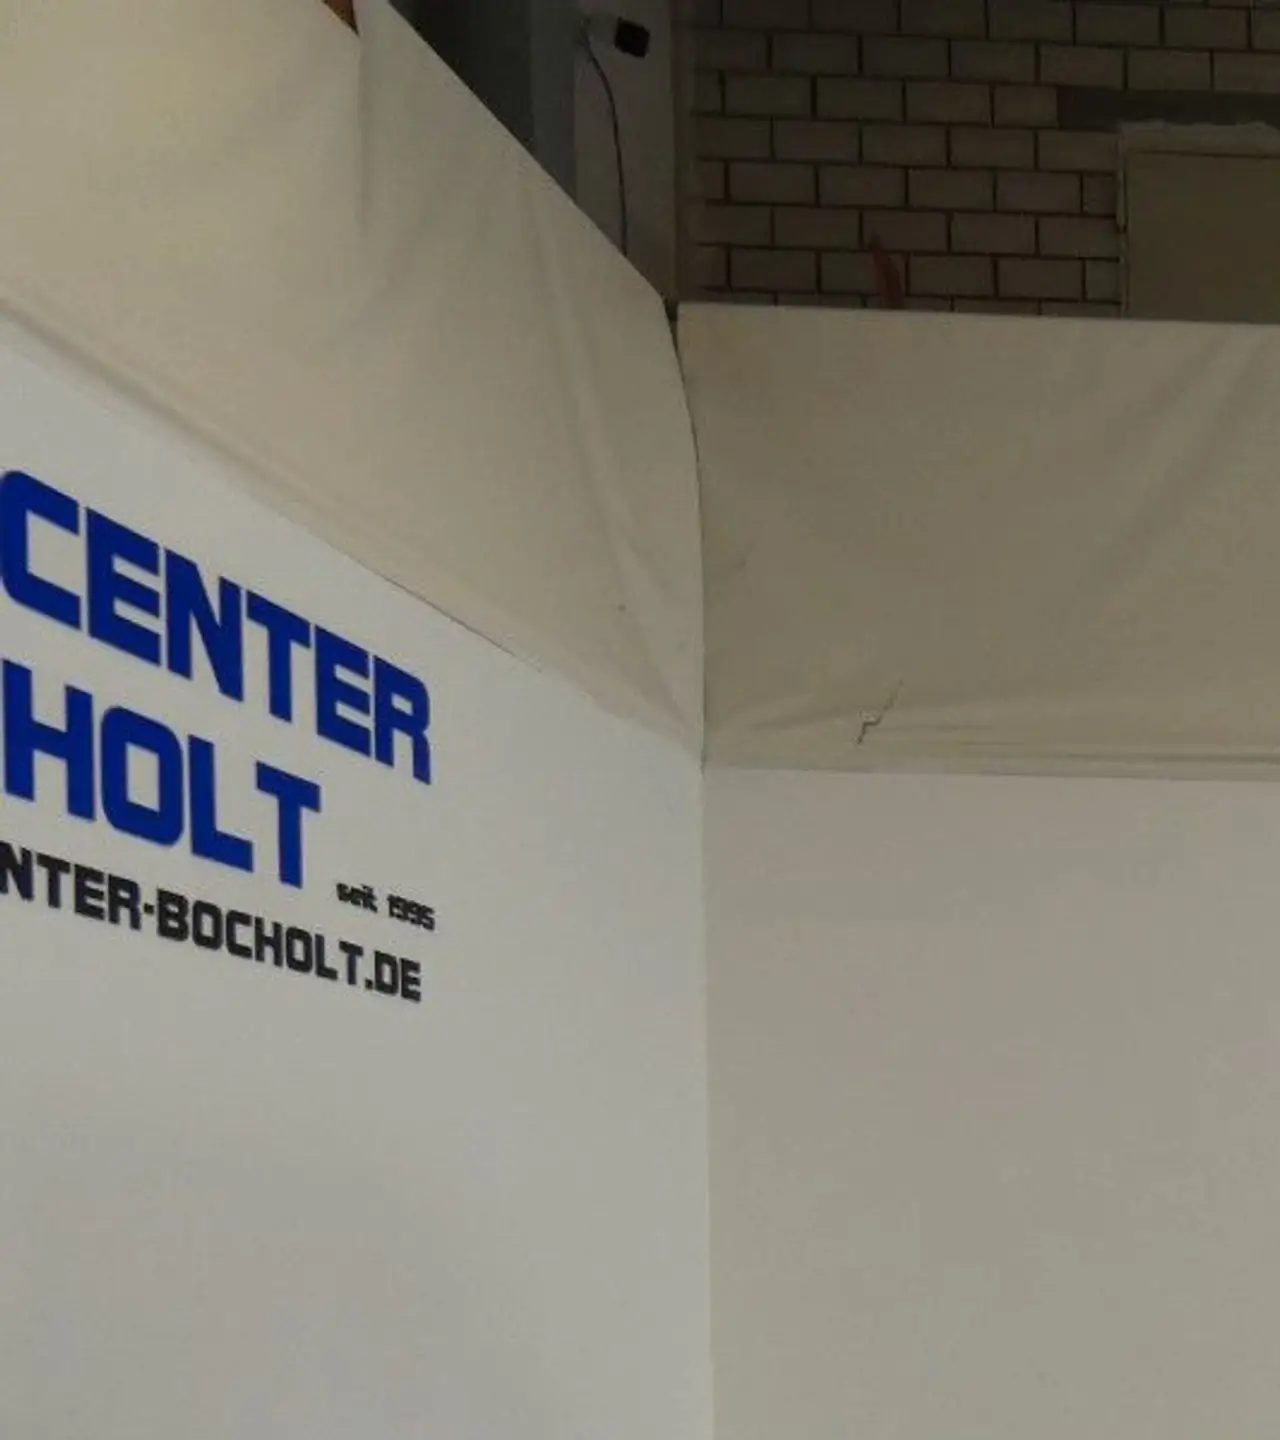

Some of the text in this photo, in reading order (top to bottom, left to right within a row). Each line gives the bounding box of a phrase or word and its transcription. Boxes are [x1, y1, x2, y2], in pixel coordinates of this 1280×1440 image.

[0, 469, 432, 785] CENTER
[1, 657, 321, 890] HOLT
[0, 839, 422, 1003] NTER-BOCHOLT.DE
